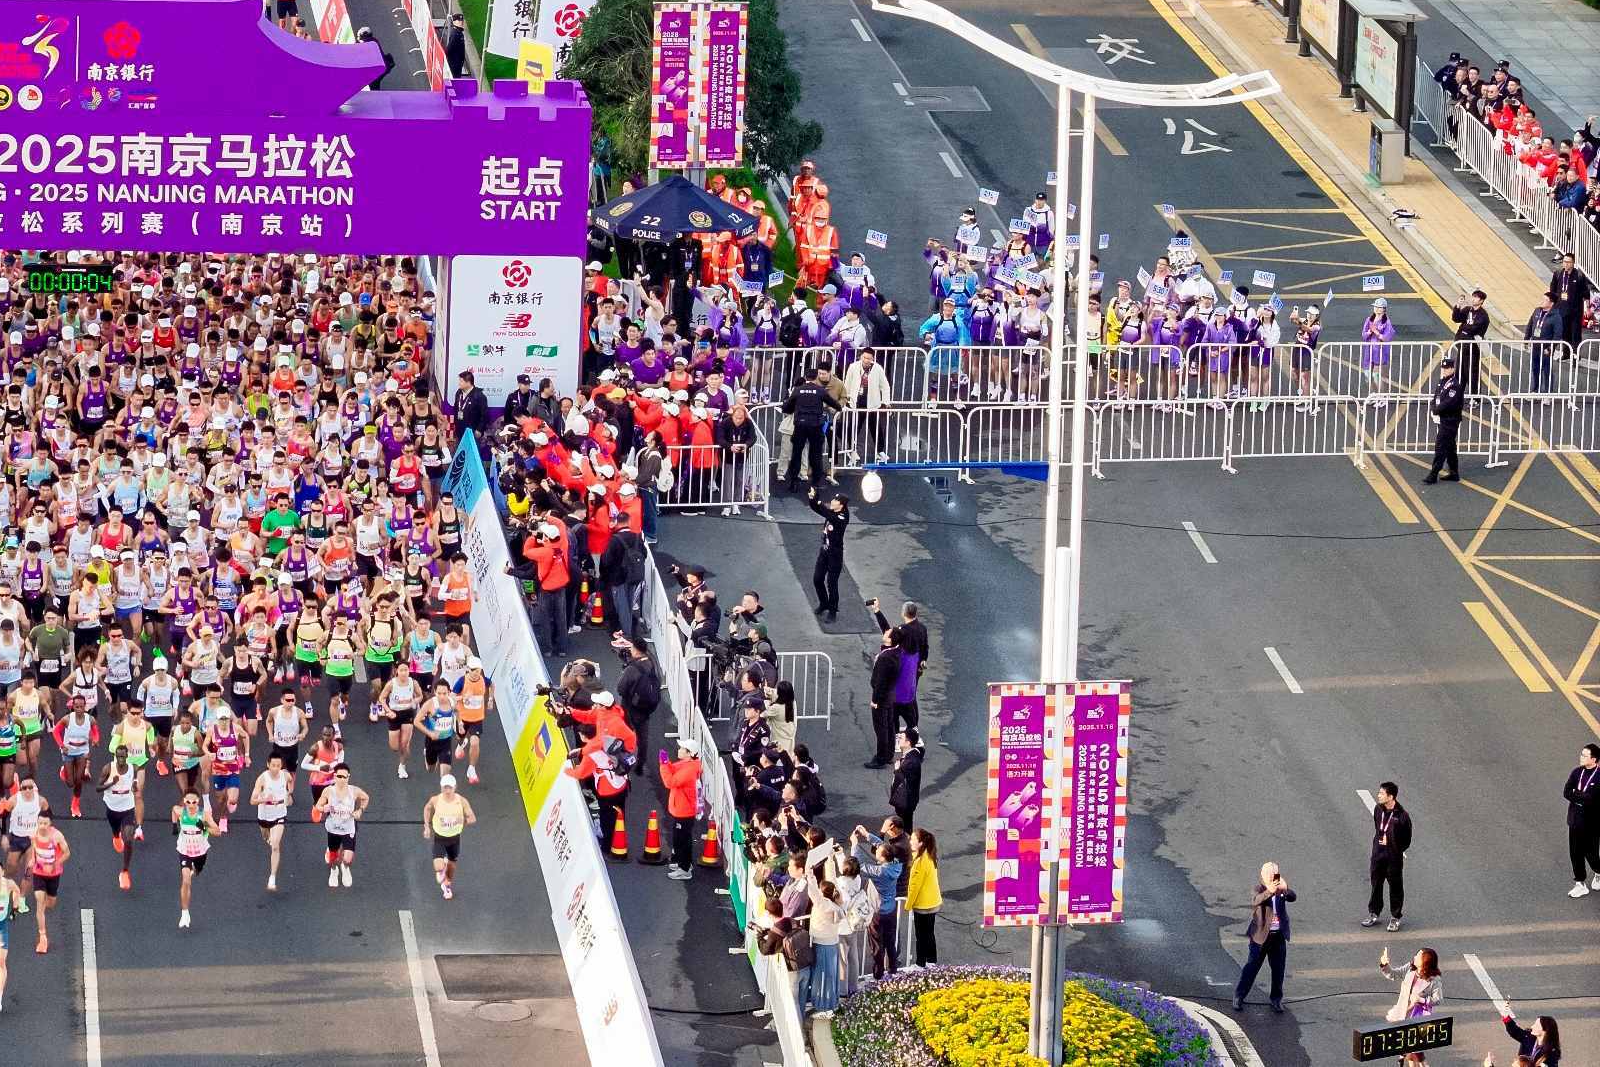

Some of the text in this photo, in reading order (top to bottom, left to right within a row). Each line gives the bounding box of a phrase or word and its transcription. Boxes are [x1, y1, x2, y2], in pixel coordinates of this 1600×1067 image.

[87, 63, 155, 81] 南京银行
[480, 155, 564, 197] 起点
[28, 183, 89, 202] 2025
[97, 184, 206, 204] NANJING
[215, 186, 354, 206] MARATHON
[480, 200, 561, 221] START
[640, 216, 661, 226] 22
[632, 228, 661, 240] POLICE
[30, 273, 112, 291] 00:00:04
[488, 291, 543, 306] 南京银行
[482, 344, 506, 357] 蒙牛
[1002, 726, 1027, 734] 2025
[1002, 734, 1042, 742] 南京马拉松
[1075, 745, 1087, 868] 2025 NANJING MARATHON
[1094, 743, 1111, 867] 2025南京马拉松
[1363, 1022, 1448, 1055] 07:30:05
